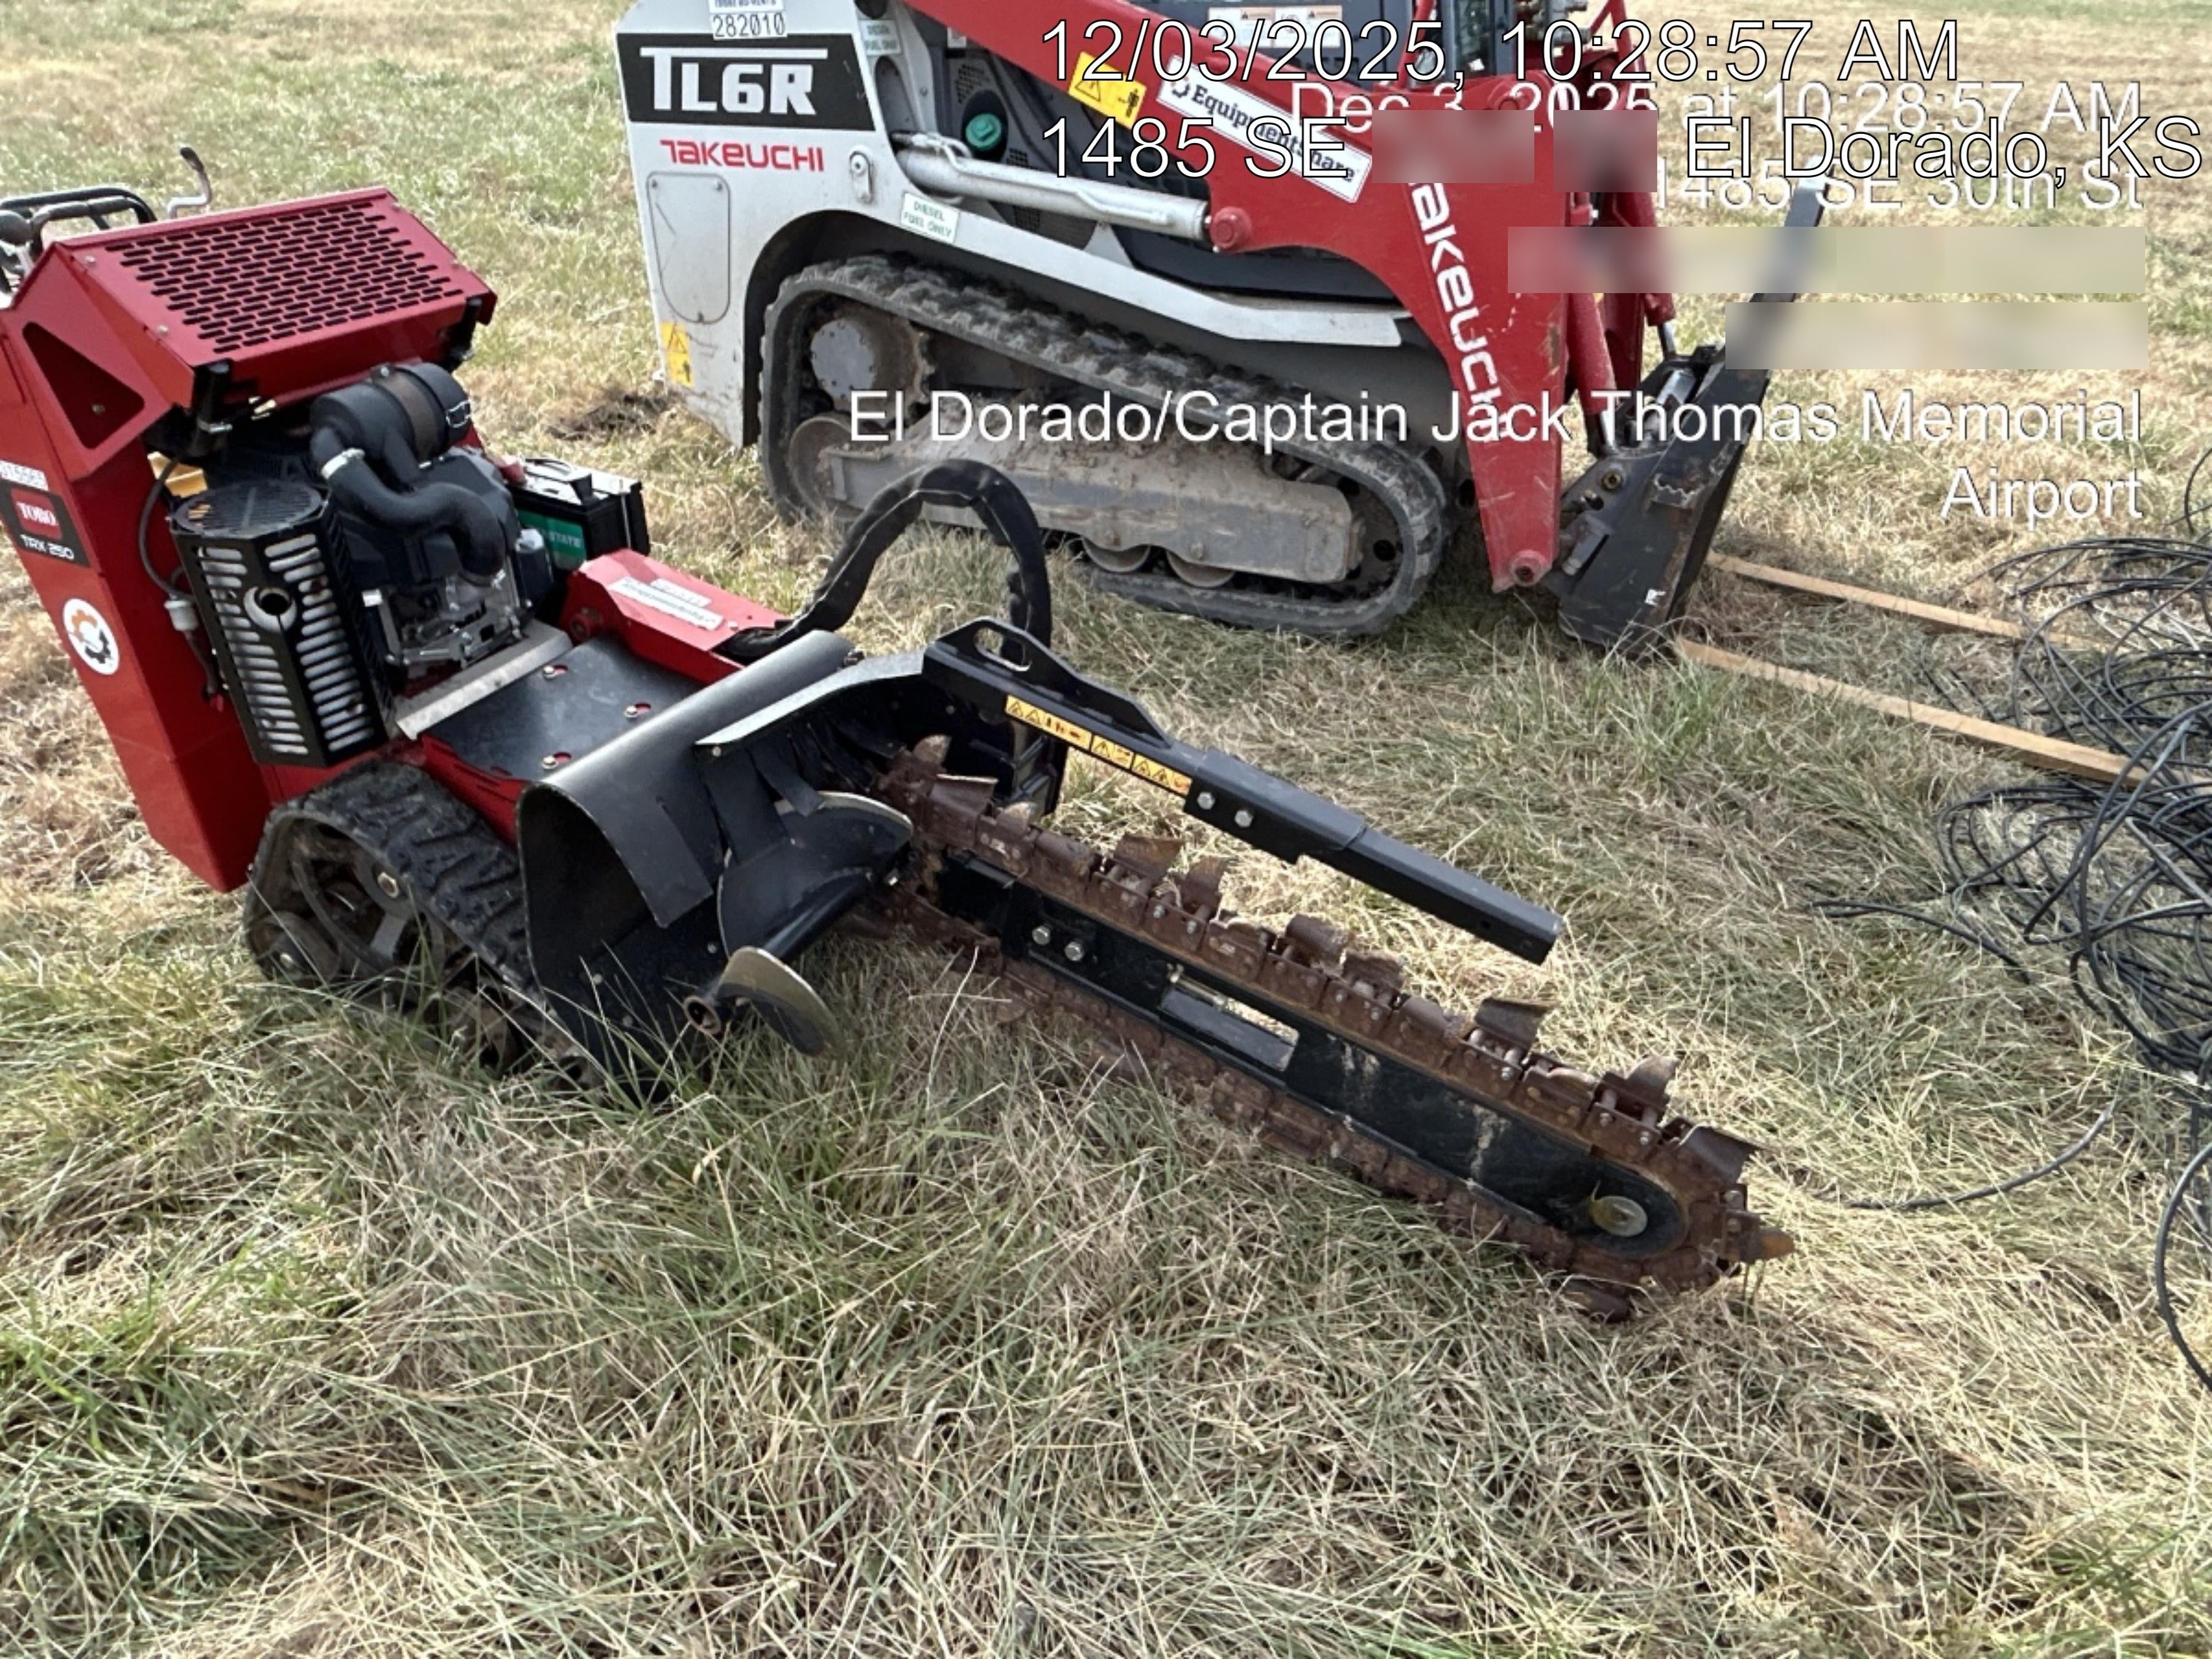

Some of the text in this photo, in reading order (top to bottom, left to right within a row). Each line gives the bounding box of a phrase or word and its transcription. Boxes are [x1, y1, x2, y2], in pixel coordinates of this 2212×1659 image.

[713, 12, 786, 37] 282010
[640, 47, 828, 116] TL6R
[660, 139, 824, 172] TAKEUCHI
[16, 500, 59, 527] TORO
[20, 533, 74, 561] TRX 250
